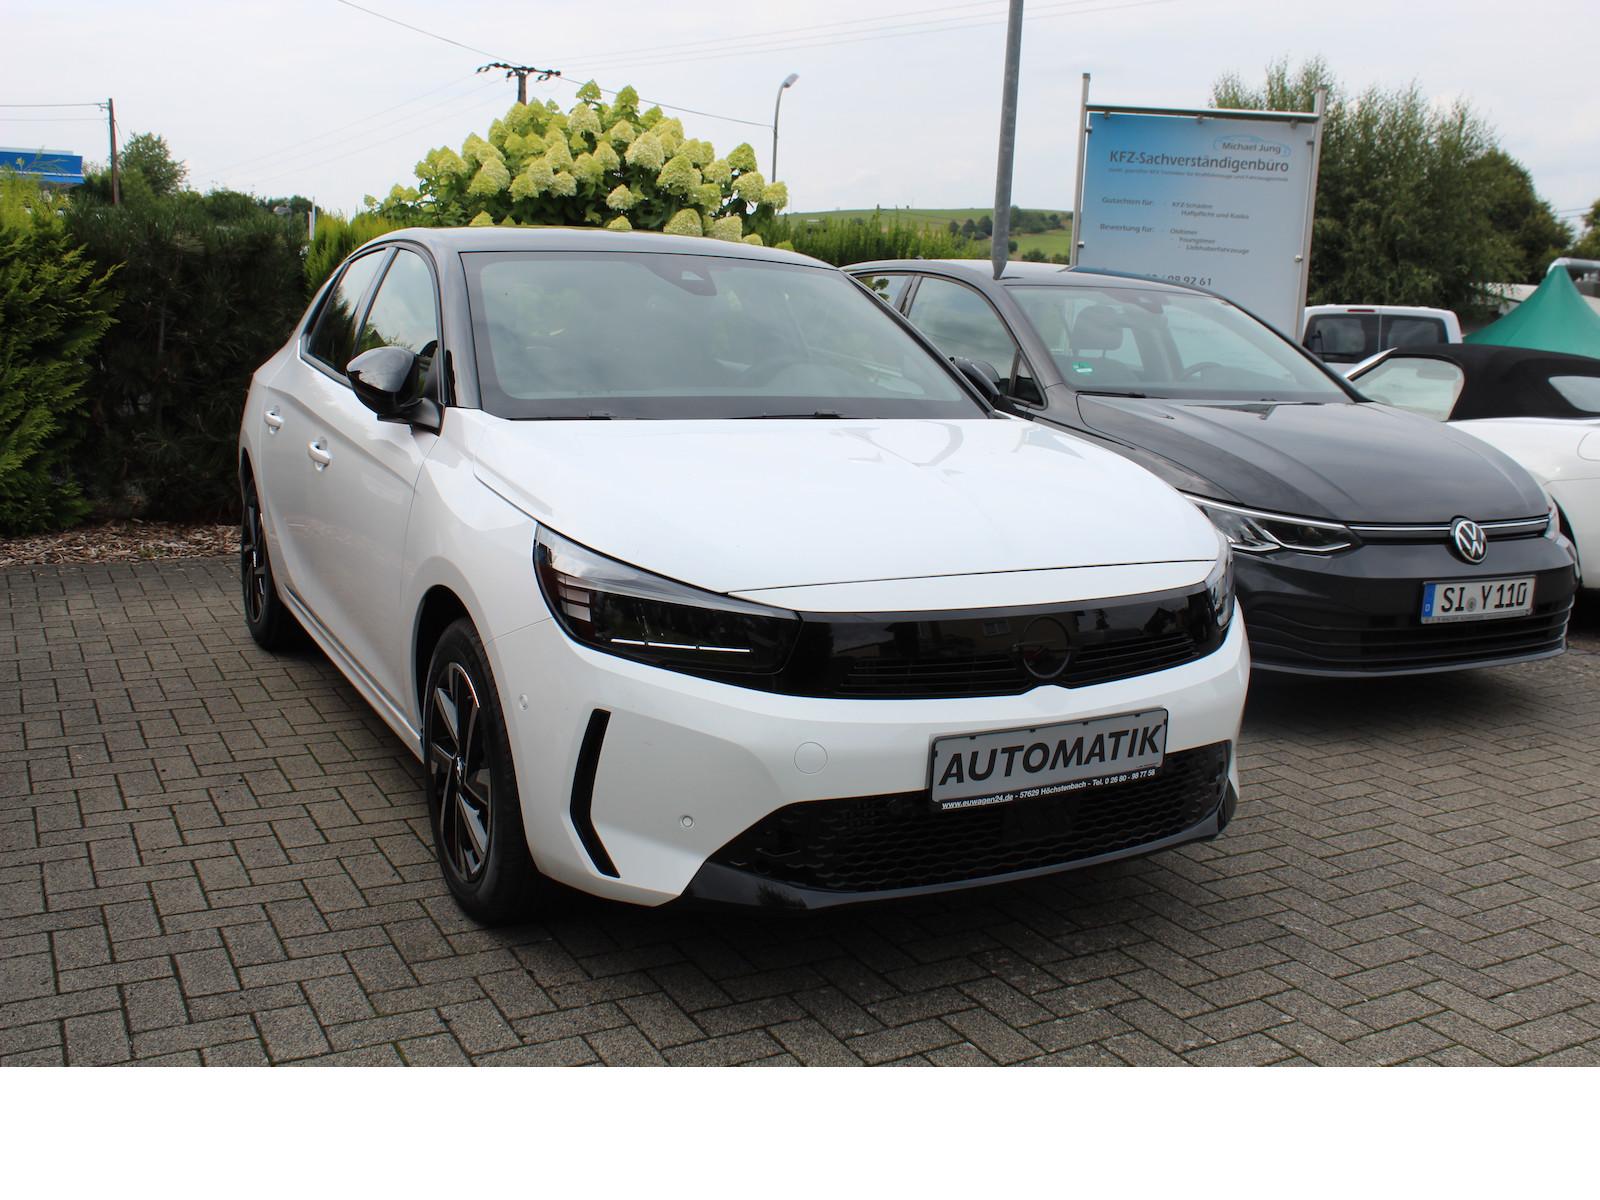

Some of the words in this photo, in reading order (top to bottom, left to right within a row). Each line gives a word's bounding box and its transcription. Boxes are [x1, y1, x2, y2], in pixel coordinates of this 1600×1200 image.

[1222, 142, 1257, 153] Michael
[1259, 144, 1282, 155] Jung
[1109, 150, 1289, 173] KFZ-Sachverständigenbüro
[1100, 223, 1141, 233] Bewertung
[1199, 277, 1212, 286] 61
[1441, 587, 1465, 613] SI
[938, 724, 1163, 786] AUTOMATIK
[941, 793, 1014, 809] www.euwagen24.de
[1019, 788, 1040, 799] 57629
[1040, 781, 1087, 795] Höchstenbach
[1092, 778, 1103, 786] Tel.
